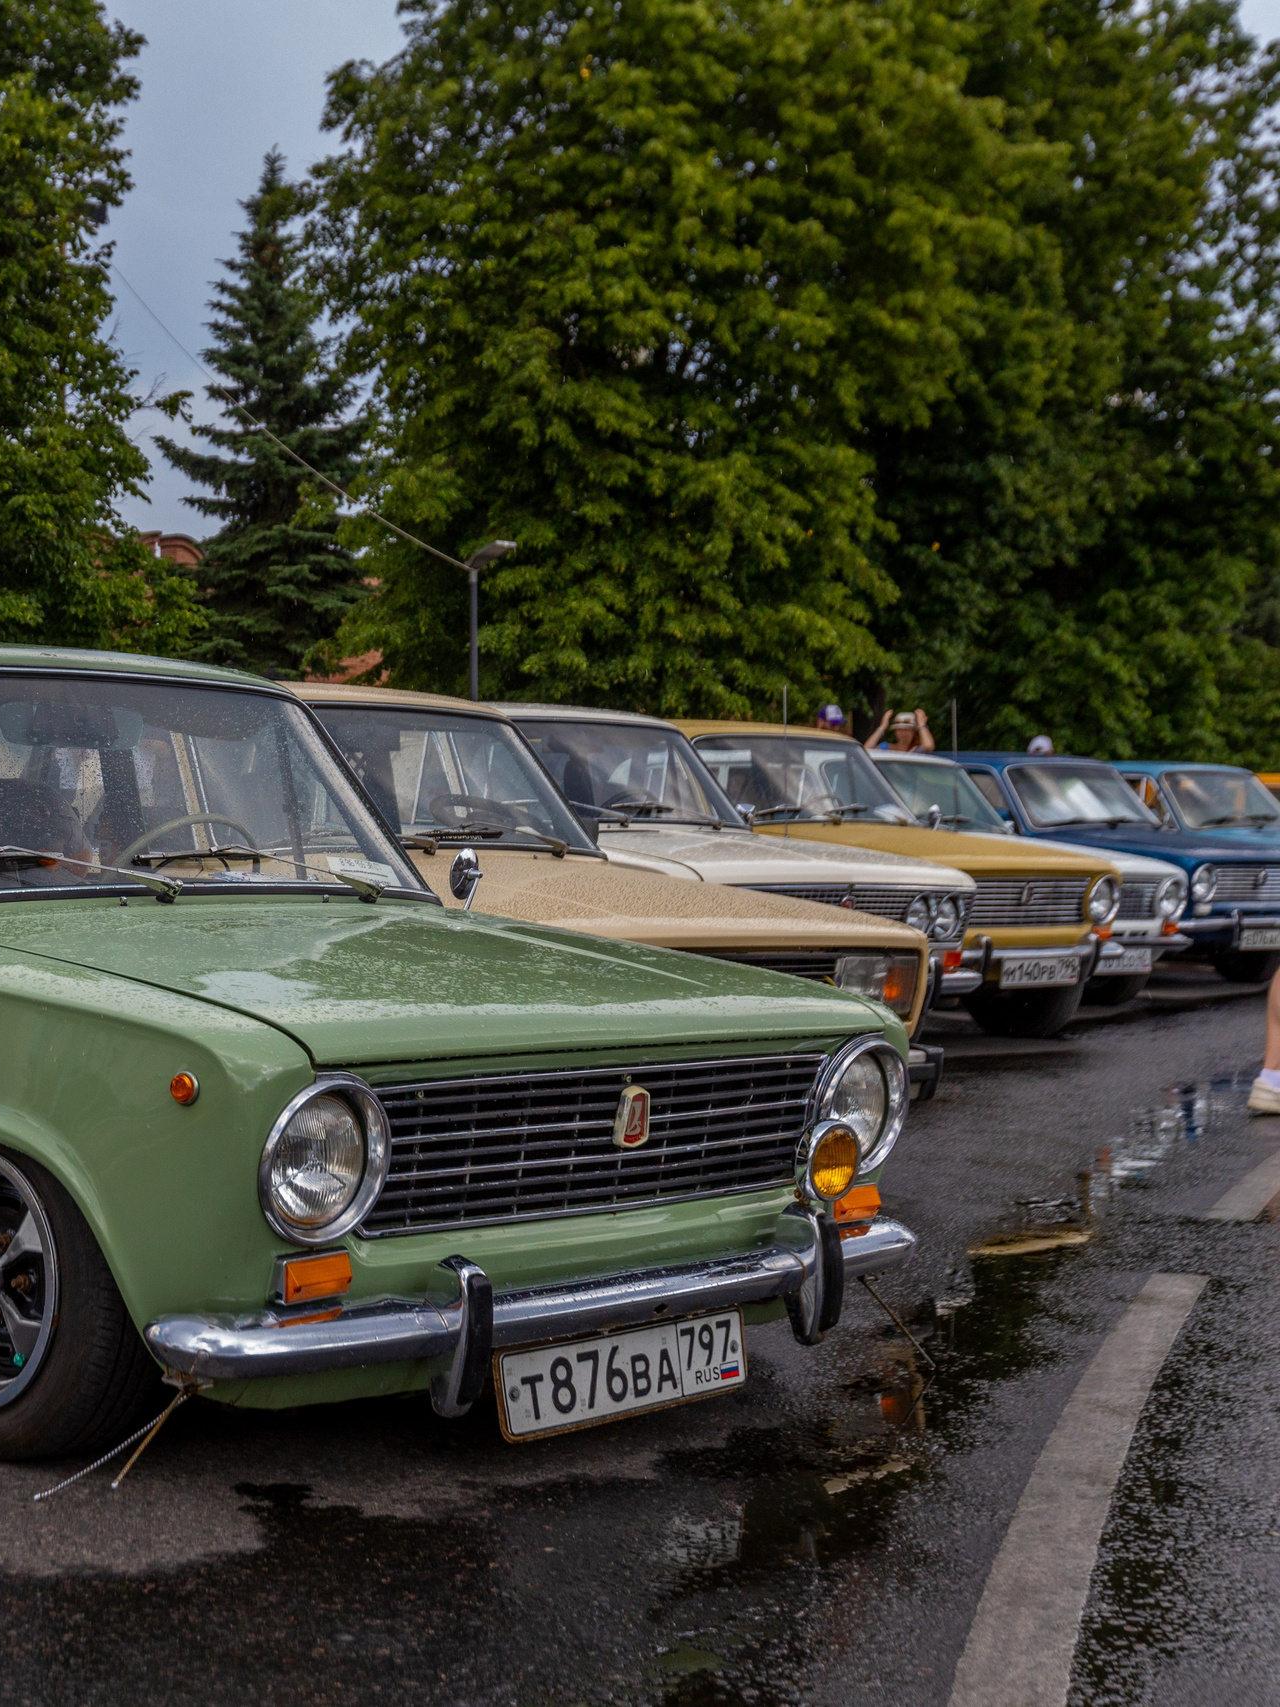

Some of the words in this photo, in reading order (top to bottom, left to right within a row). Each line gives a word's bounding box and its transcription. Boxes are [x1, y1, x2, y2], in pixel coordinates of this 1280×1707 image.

[1003, 960, 1057, 982] М140РВ
[520, 1345, 678, 1420] Т876ВА
[679, 1319, 731, 1371] 797
[695, 1366, 720, 1385] RUS
